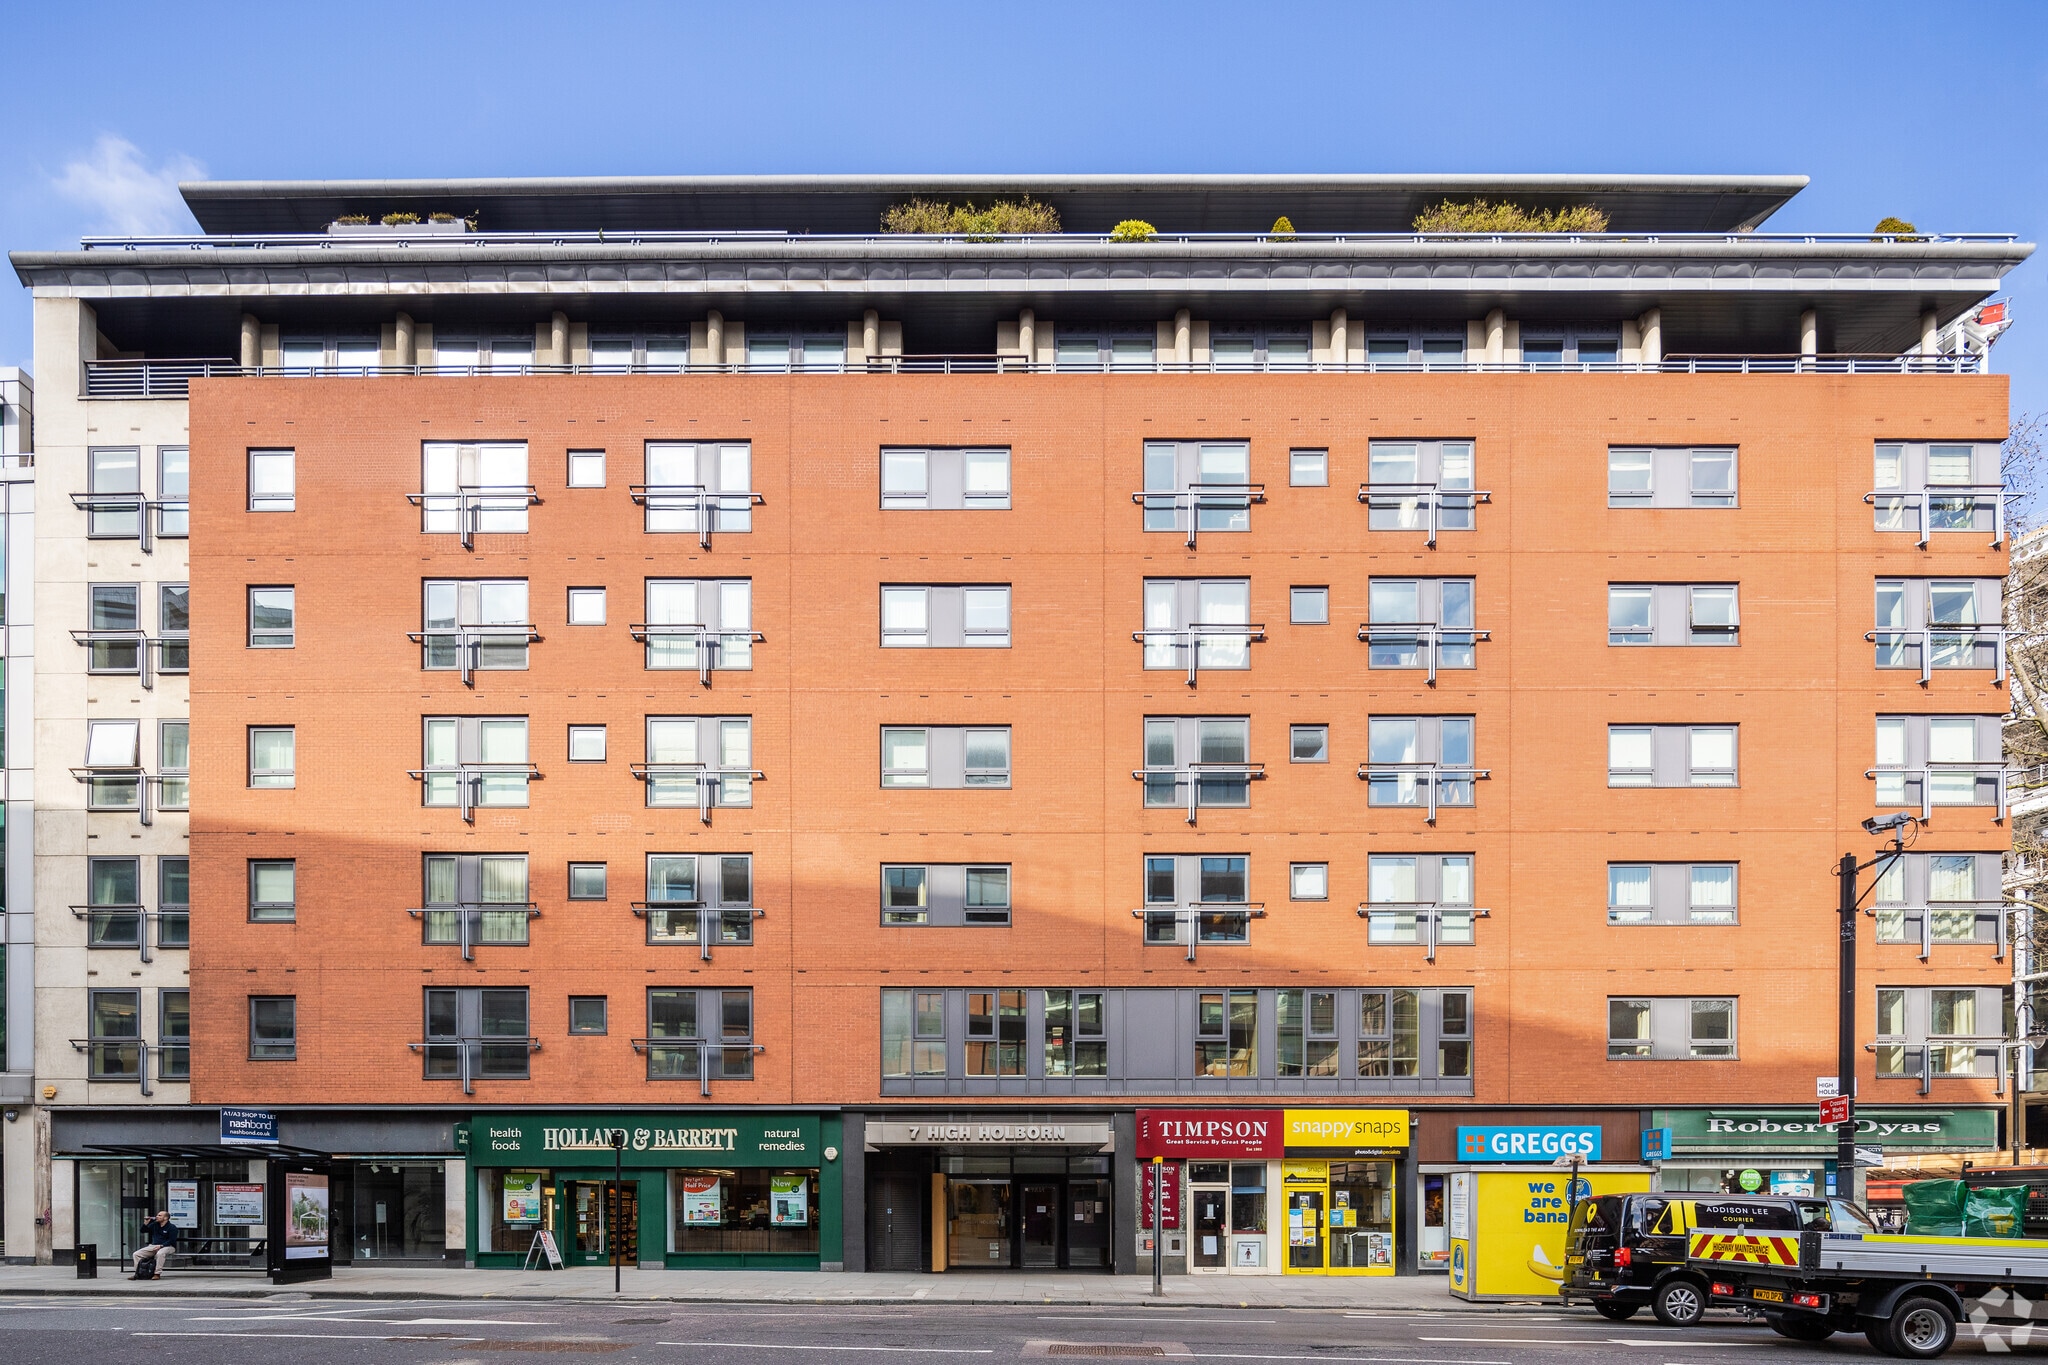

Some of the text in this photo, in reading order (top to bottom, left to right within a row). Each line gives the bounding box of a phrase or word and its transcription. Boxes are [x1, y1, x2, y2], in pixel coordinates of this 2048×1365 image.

[230, 1119, 271, 1130] nashbond
[1159, 1121, 1268, 1137] TIMPSON
[1706, 1118, 1941, 1136] Robert Dyas
[490, 1127, 522, 1138] health
[764, 1128, 800, 1138] natural
[909, 1126, 1065, 1141] 7 HIGH HOLBORN
[632, 1128, 650, 1151] &
[654, 1128, 738, 1150] BARRETT
[1491, 1133, 1594, 1154] GREGGS
[492, 1140, 521, 1151] foods
[758, 1140, 805, 1151] remedies
[1645, 1150, 1663, 1158] GREGGS
[505, 1176, 525, 1185] New
[772, 1178, 791, 1187] New
[1528, 1183, 1555, 1193] we
[1531, 1197, 1562, 1208] are
[1706, 1206, 1748, 1214] ADDISON
[1524, 1209, 1568, 1223] bana
[1713, 1242, 1769, 1255] HIGHWAY MAINTENANCE
